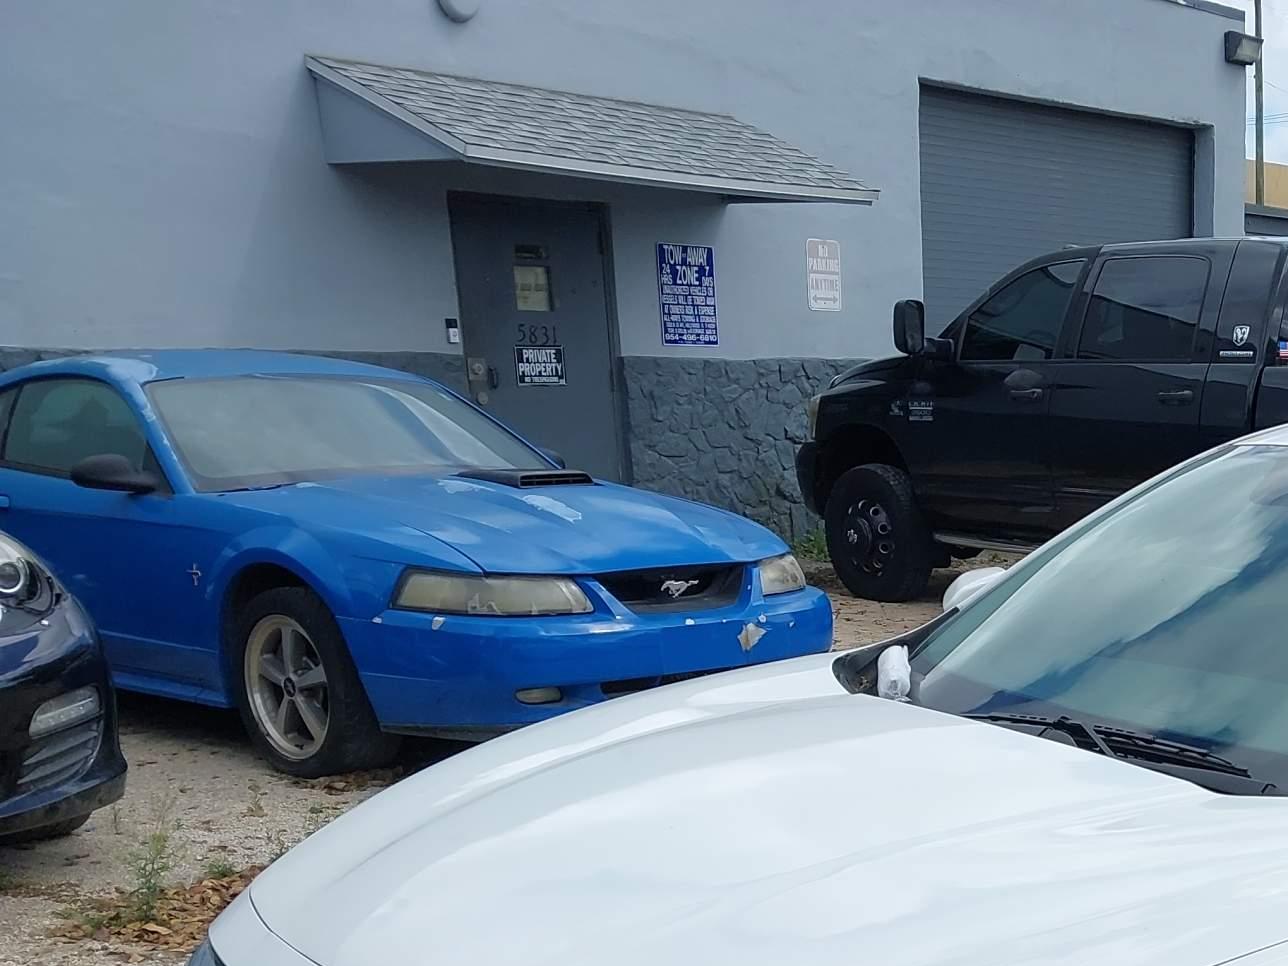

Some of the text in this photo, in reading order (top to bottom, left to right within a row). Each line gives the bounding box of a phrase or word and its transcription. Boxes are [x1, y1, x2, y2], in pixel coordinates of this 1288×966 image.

[661, 263, 671, 274] 24
[675, 265, 700, 286] ZONE
[704, 266, 710, 277] 7
[516, 323, 557, 345] 5831
[522, 349, 557, 363] PRIVATE
[518, 362, 562, 377] PROPERTY
